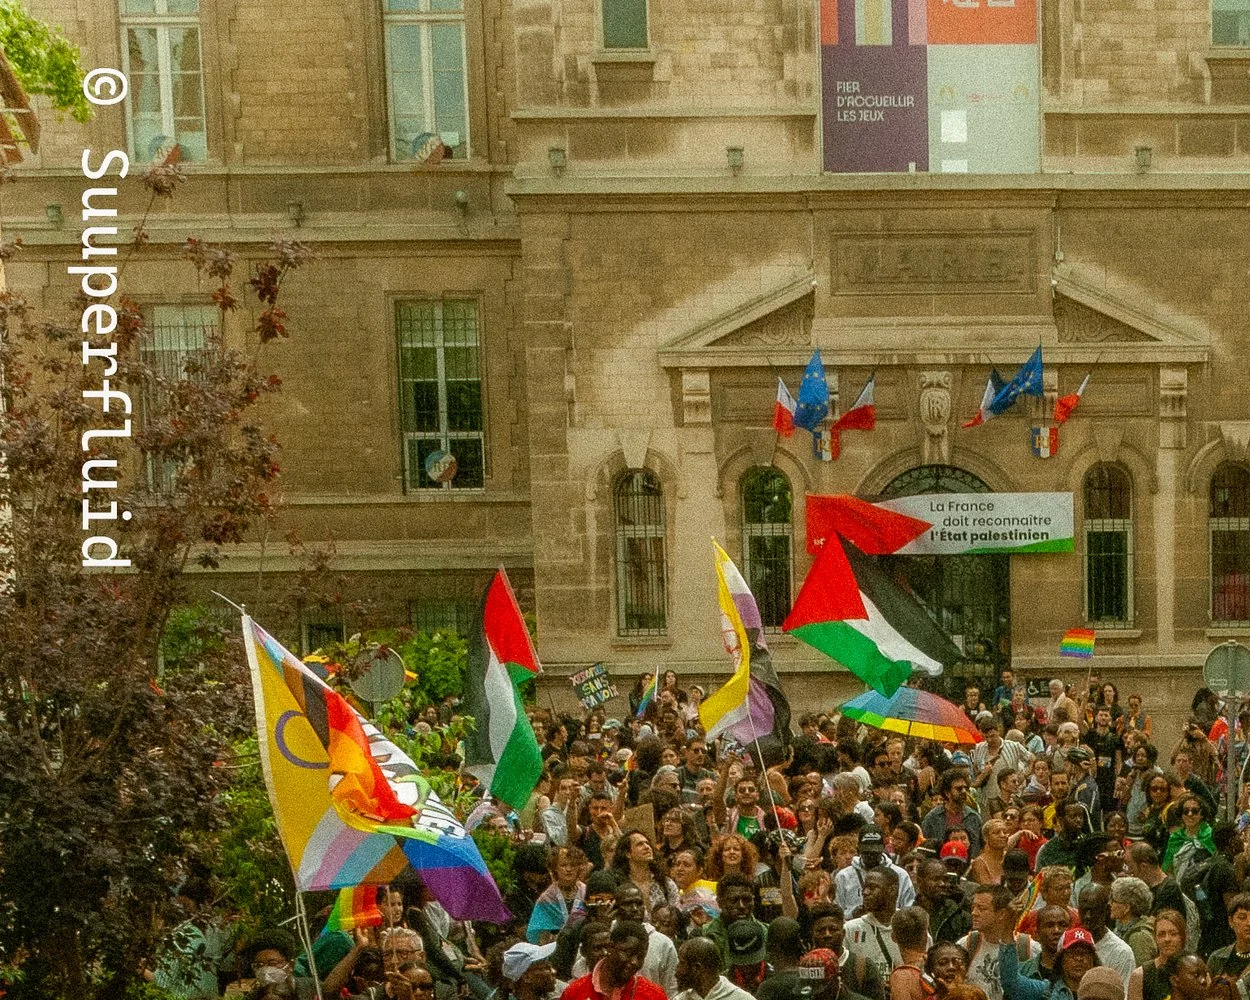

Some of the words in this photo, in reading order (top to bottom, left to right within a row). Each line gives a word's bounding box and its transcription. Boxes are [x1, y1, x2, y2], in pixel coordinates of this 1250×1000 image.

[836, 81, 860, 93] FIER
[836, 95, 915, 108] D'ACCUEILLIR
[837, 110, 857, 122] LES
[859, 110, 885, 122] JEUX
[930, 500, 945, 512] La
[948, 500, 995, 512] France
[942, 514, 969, 527] doit
[972, 514, 1052, 527] reconnaître
[930, 527, 968, 541] l'État
[970, 530, 1050, 544] palestinien
